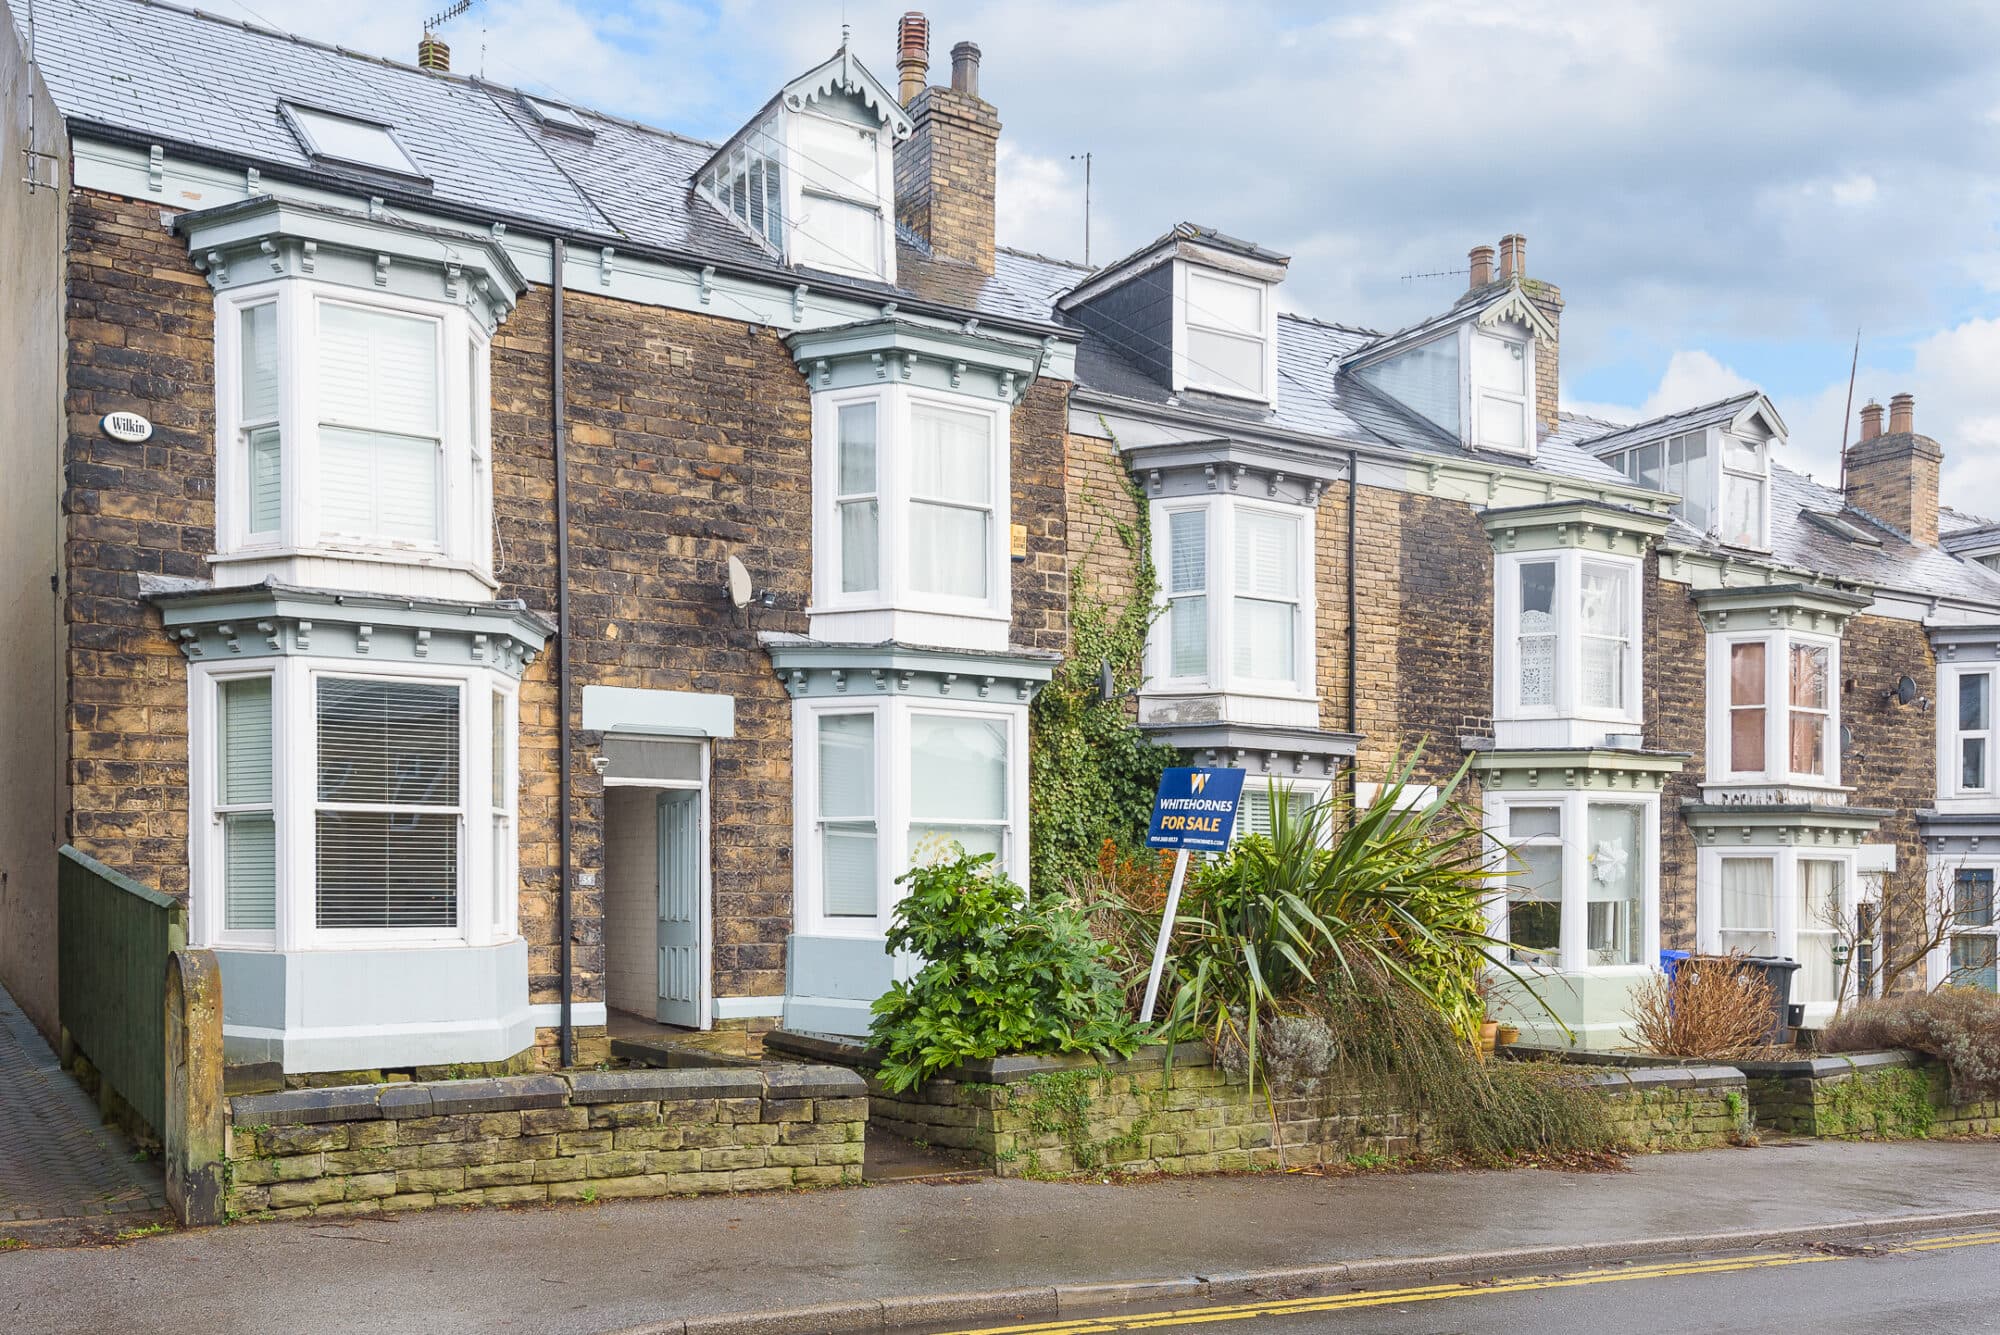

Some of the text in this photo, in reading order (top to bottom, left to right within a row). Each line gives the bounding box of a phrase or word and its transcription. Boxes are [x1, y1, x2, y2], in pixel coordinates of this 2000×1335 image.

[112, 416, 145, 434] Wilkin
[1160, 798, 1233, 812] WHITEHORNES
[1160, 816, 1222, 832] FOR SALE
